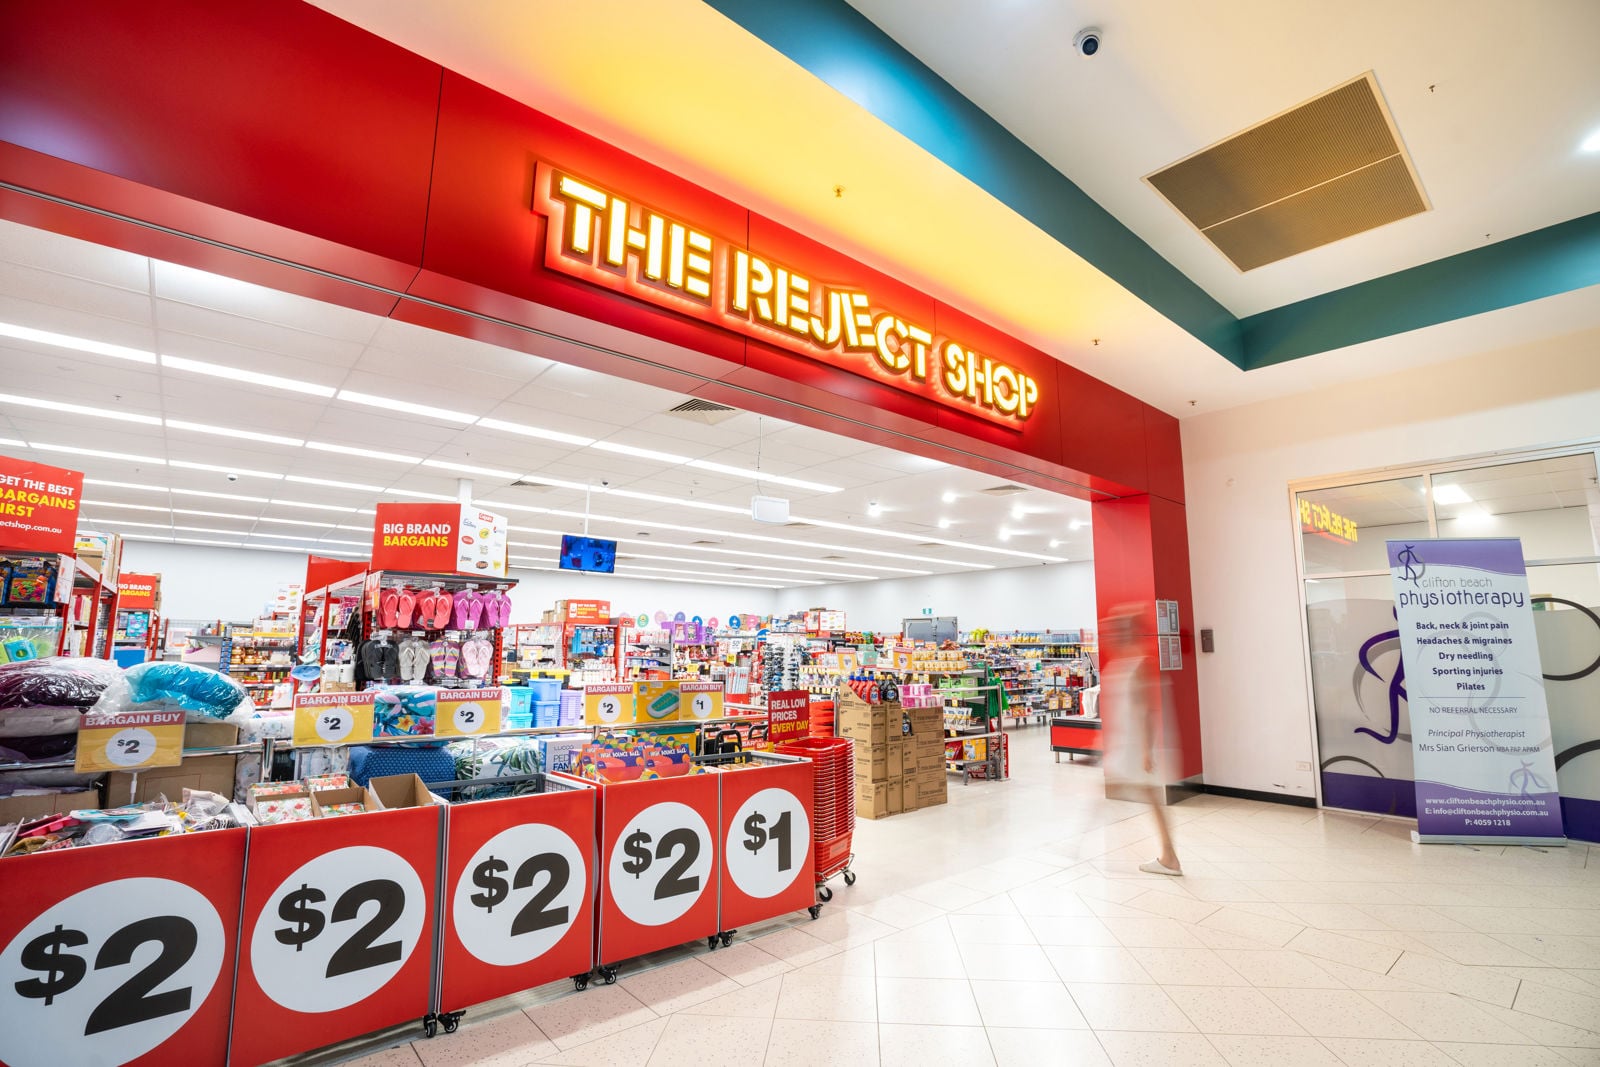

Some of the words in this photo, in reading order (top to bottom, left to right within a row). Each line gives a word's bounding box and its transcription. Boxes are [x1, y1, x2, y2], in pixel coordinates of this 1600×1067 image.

[559, 175, 712, 298] THE
[734, 250, 932, 379] REJECT
[944, 342, 1039, 417] SHOP
[23, 478, 46, 491] THE
[47, 483, 74, 496] BEST
[0, 502, 35, 518] IRST
[382, 523, 404, 535] BIG
[406, 523, 451, 535] BRAND
[383, 535, 449, 547] BARGAINS
[1422, 577, 1456, 588] clifton
[1460, 577, 1493, 588] beach
[1399, 589, 1524, 608] physiotherapy
[1416, 622, 1437, 630] Back,
[1470, 622, 1489, 631] joint
[1490, 622, 1509, 631] pain
[1417, 637, 1462, 645] Headaches
[1464, 637, 1470, 645] &
[1472, 637, 1512, 646] migraines
[1439, 652, 1455, 661] Dry
[1457, 652, 1493, 661] needling
[1432, 667, 1471, 676] Sporting
[1473, 667, 1503, 676] injuries
[587, 685, 618, 693] BARGAIN
[1457, 683, 1485, 691] Pilates
[300, 695, 349, 705] BARGAIN
[350, 694, 371, 703] BUY
[439, 691, 480, 700] BARGAIN
[481, 690, 499, 698] BUY
[603, 702, 613, 713] $2
[696, 700, 704, 710] $1
[771, 699, 790, 710] REAL
[791, 698, 806, 708] LOW
[85, 714, 151, 726] BARGAIN
[152, 713, 181, 723] BUY
[460, 710, 474, 723] $2
[771, 710, 797, 721] PRICES
[324, 716, 341, 730] $2
[771, 722, 796, 734] EVERY
[796, 720, 809, 731] DAY
[1428, 729, 1464, 738] Principal
[1465, 730, 1526, 740] Physiotherapist
[117, 738, 140, 754] $2
[1419, 743, 1434, 752] Mrs
[1436, 743, 1455, 752] Sian
[1457, 744, 1495, 753] Grierson
[1425, 797, 1545, 807] www.cliftonbeachphysio.com.au
[1433, 808, 1549, 817] info@cliftonbeachphysio.com.au
[1493, 819, 1511, 827] 1218
[743, 811, 792, 872] $1
[622, 828, 701, 900] $2
[470, 852, 570, 937] $2
[275, 879, 406, 979] $2
[14, 915, 198, 1036] $2
